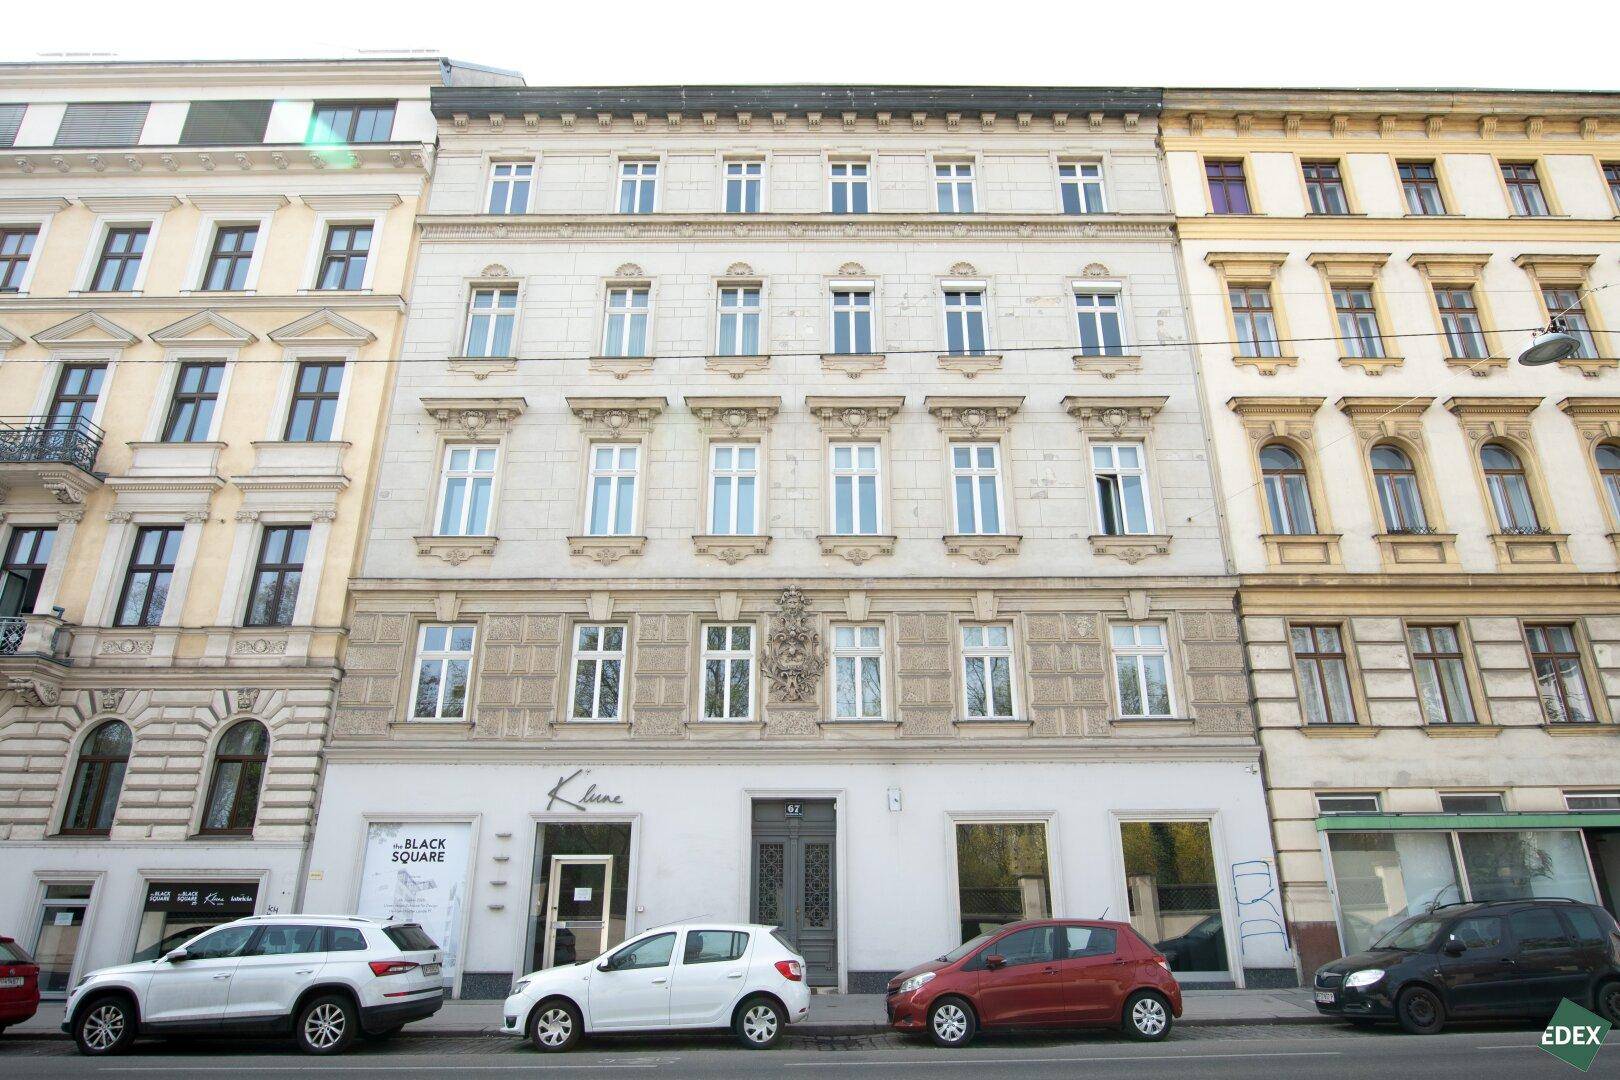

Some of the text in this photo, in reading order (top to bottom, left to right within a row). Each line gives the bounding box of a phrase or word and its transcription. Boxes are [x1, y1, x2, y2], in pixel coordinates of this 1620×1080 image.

[787, 804, 801, 813] 67
[405, 838, 446, 850] BLACK
[391, 851, 445, 864] SQUARE
